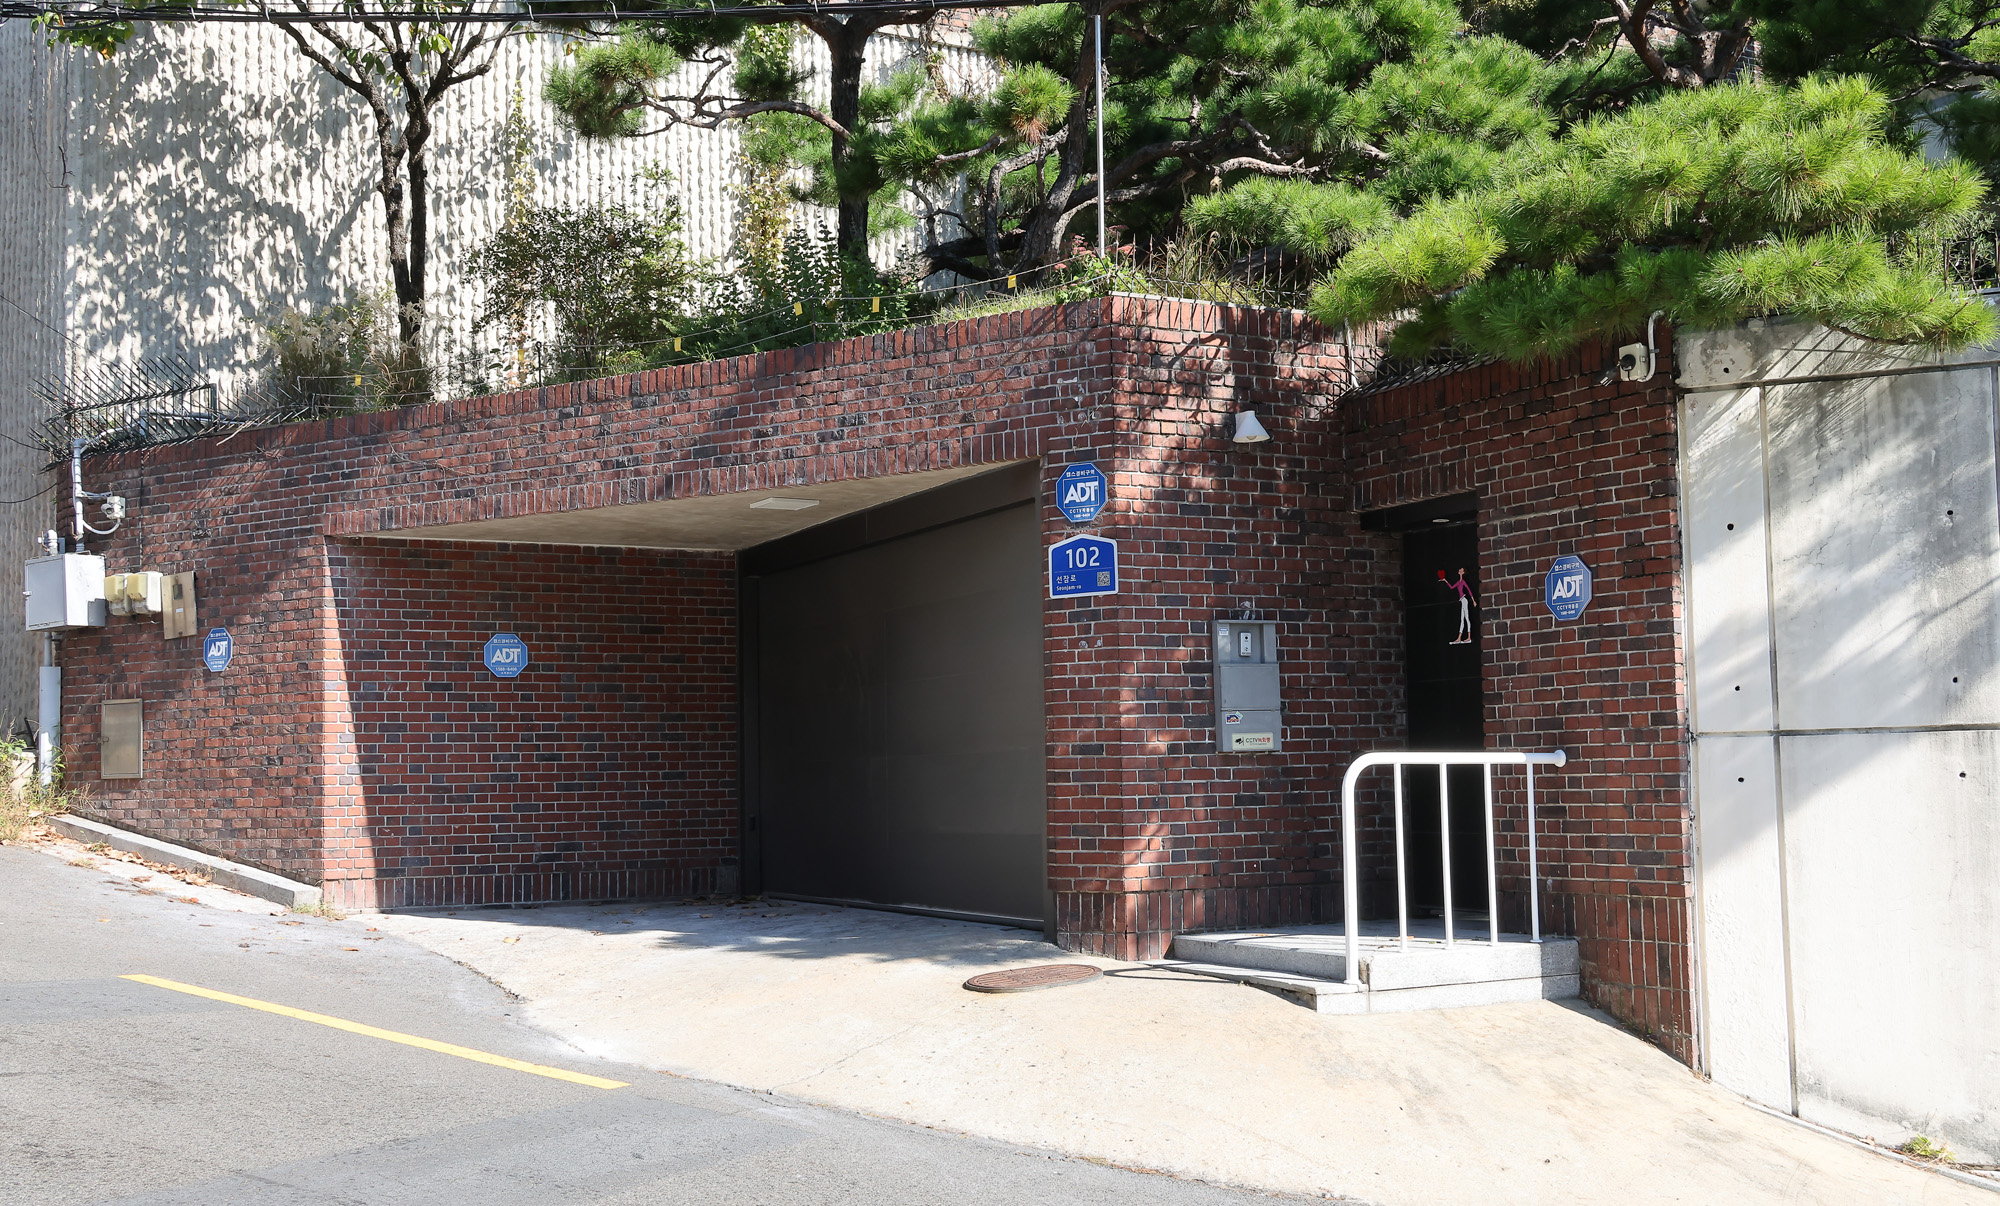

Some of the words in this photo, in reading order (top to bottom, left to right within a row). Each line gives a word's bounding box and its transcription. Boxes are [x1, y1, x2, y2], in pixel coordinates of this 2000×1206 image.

[1064, 481, 1099, 504] ADT
[1065, 546, 1100, 569] 102
[1056, 574, 1077, 584] 선잠로
[1552, 574, 1584, 600] ADT
[1056, 584, 1082, 592] Seonjam-ro
[208, 641, 228, 658] ADT
[491, 647, 521, 664] ADT
